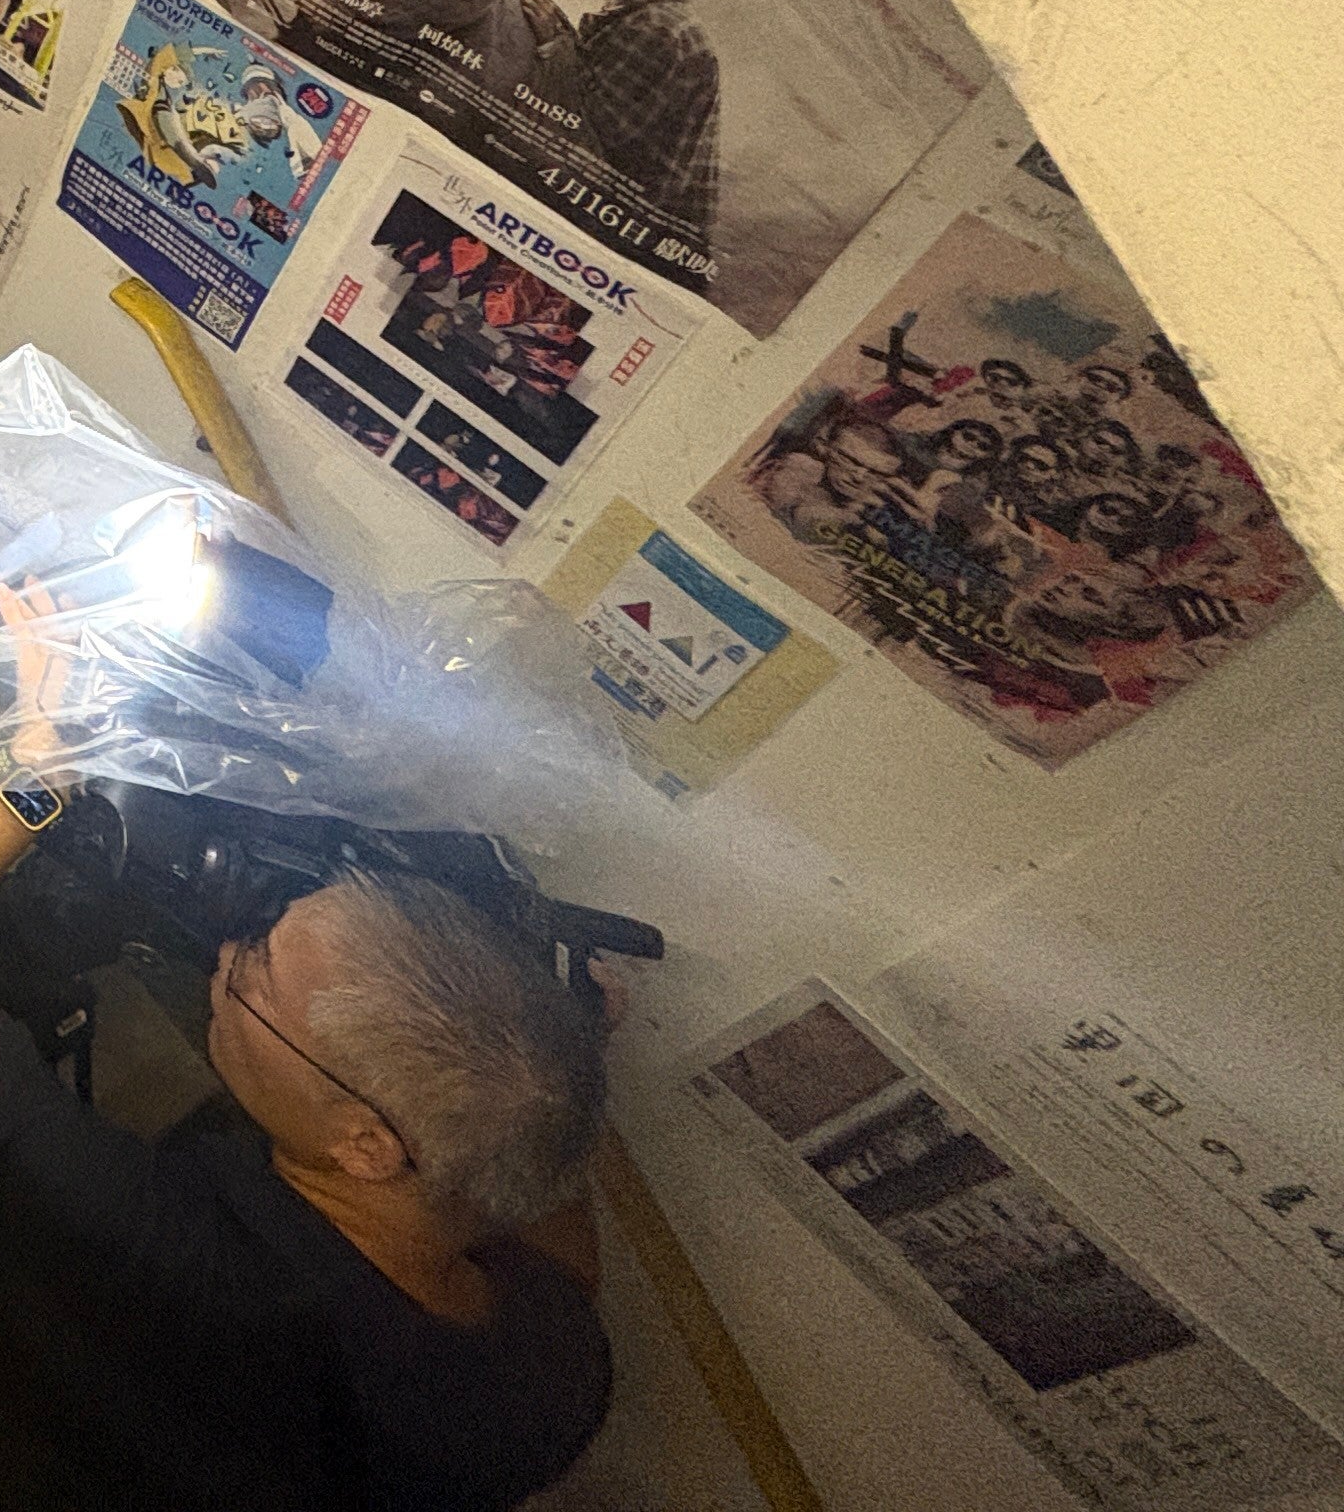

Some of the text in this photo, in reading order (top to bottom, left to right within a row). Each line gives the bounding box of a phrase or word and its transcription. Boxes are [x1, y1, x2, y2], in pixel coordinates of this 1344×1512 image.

[512, 80, 584, 134] 9m88
[124, 150, 264, 261] ARTBOOK
[535, 162, 649, 244] 4月16日
[472, 194, 637, 309] ARTBOOK
